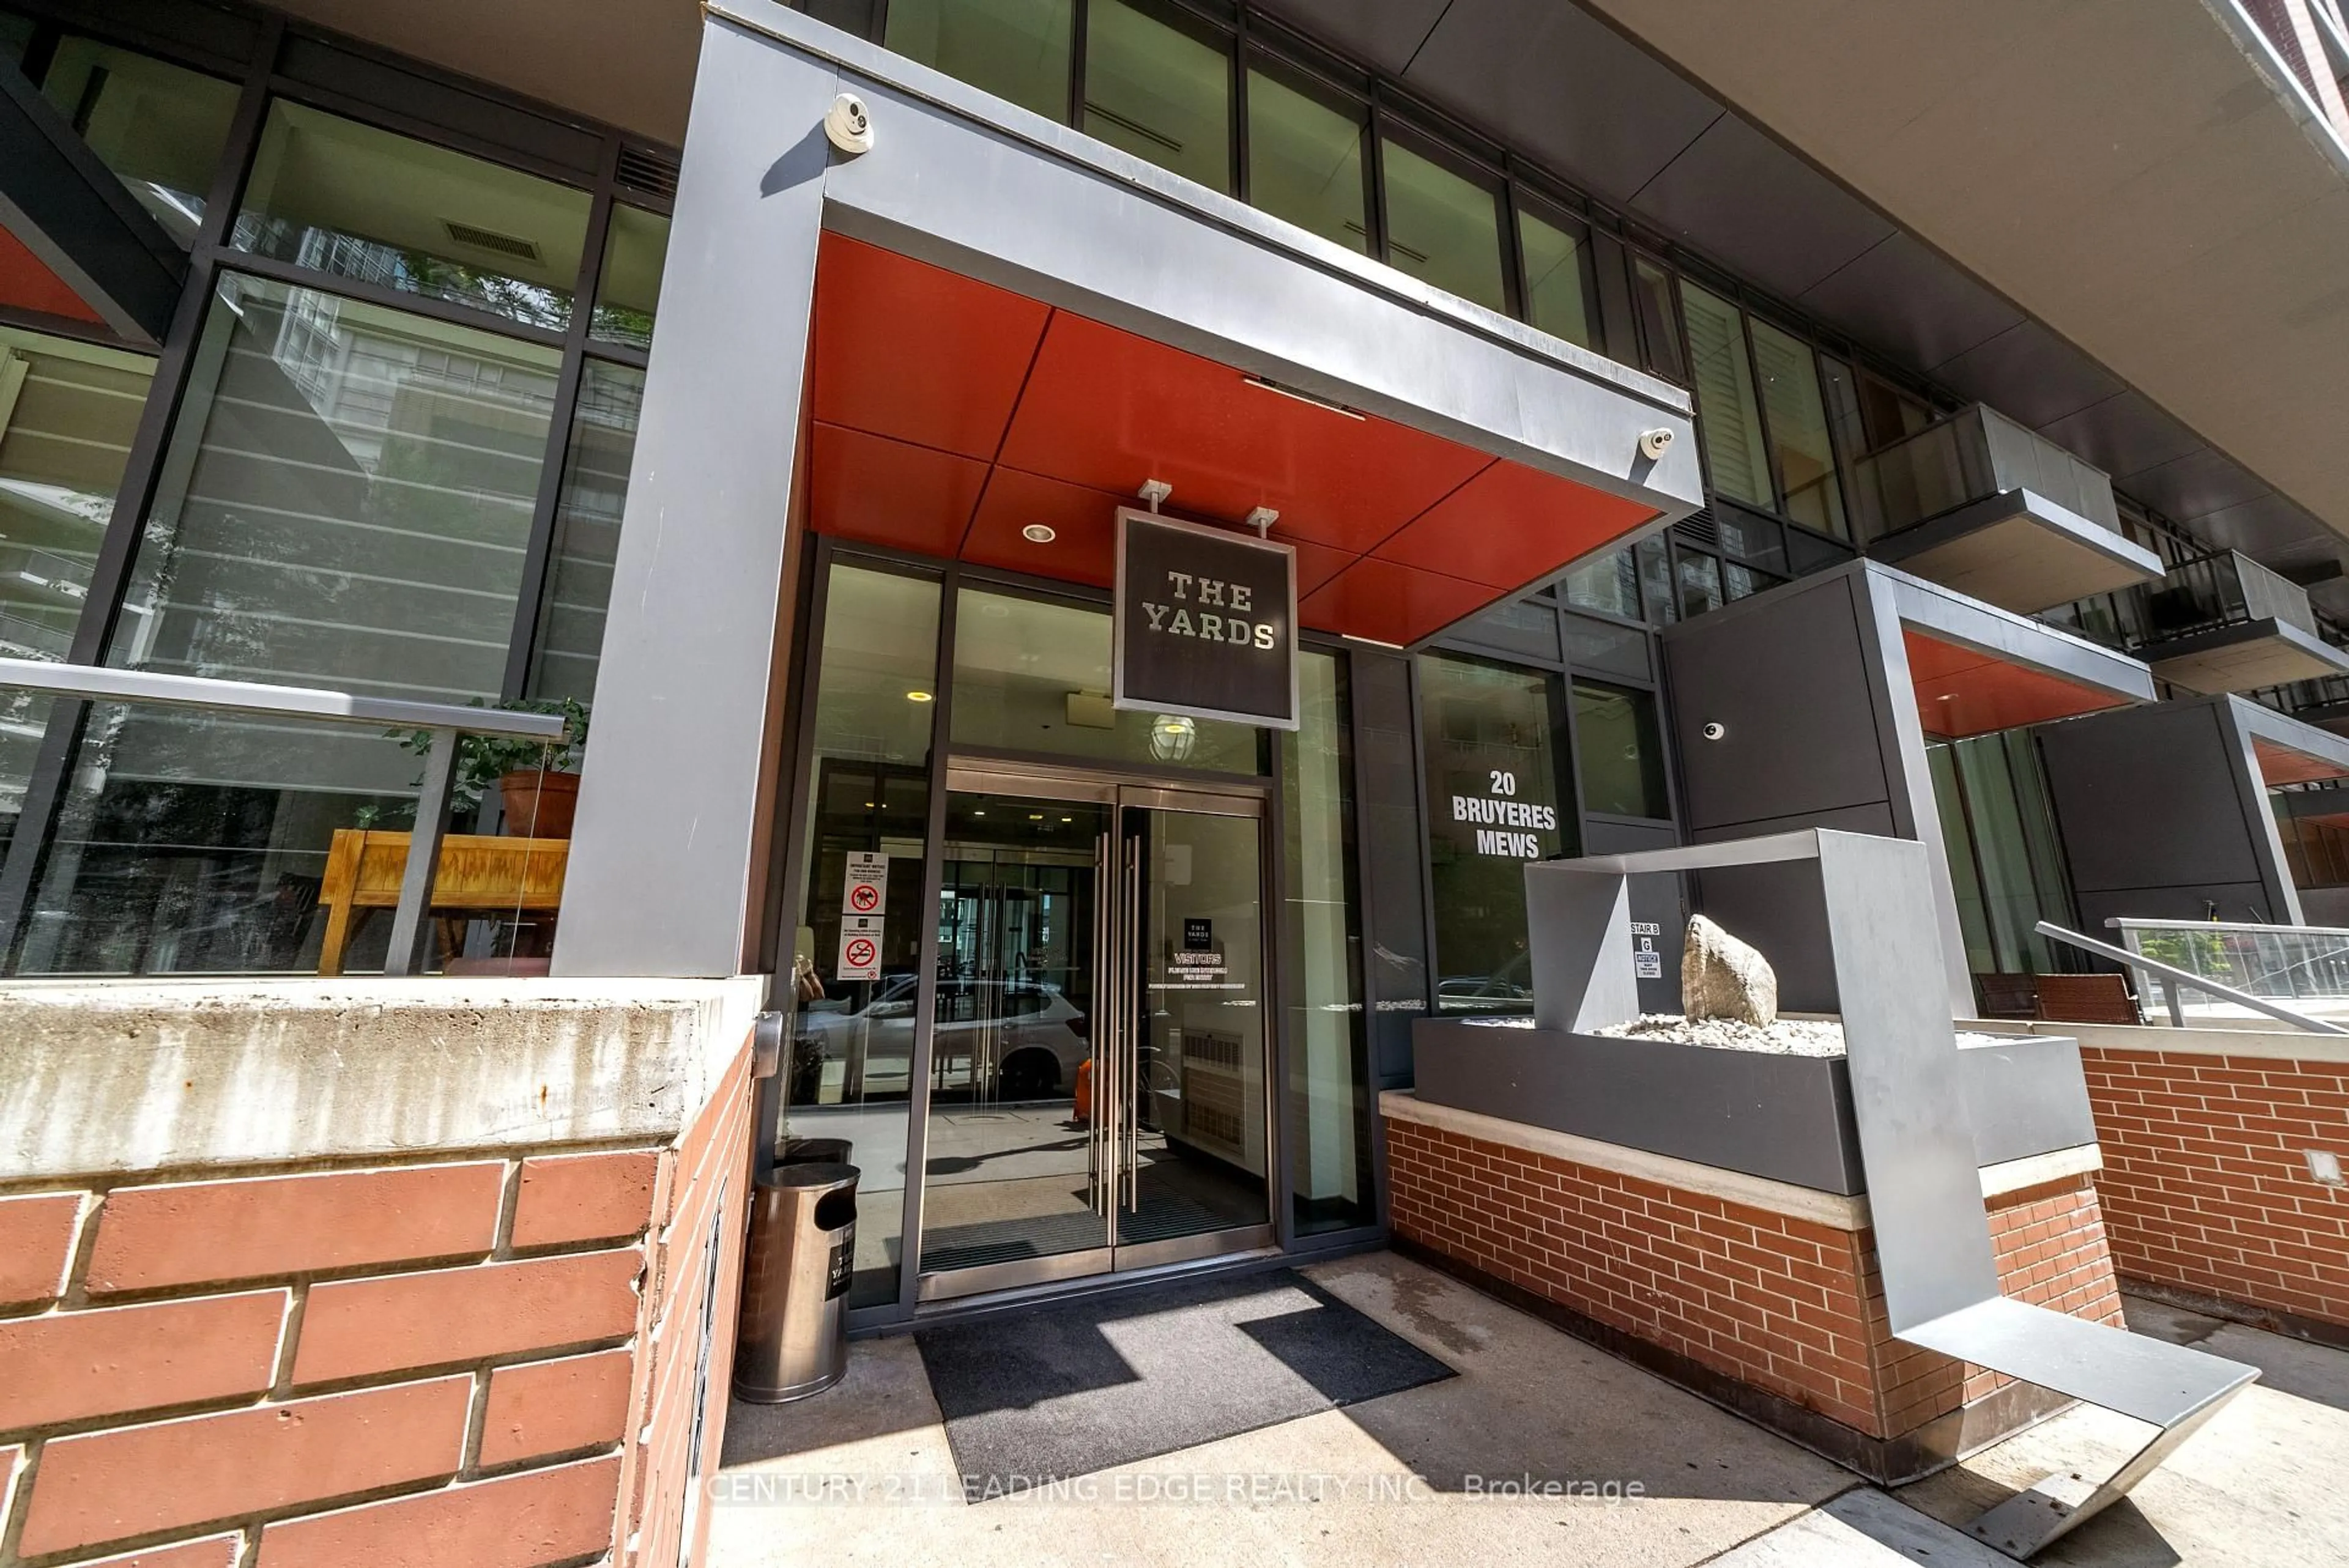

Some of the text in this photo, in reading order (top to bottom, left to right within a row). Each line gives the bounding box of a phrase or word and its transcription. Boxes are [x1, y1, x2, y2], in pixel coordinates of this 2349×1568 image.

[1168, 571, 1252, 611] THE
[1142, 602, 1275, 649] YARDS
[1490, 771, 1515, 796] 20
[1452, 796, 1556, 830] BRUYERES
[1476, 829, 1539, 858] MEWS
[1631, 923, 1658, 934] STAIR B
[1174, 953, 1222, 964] VISITORS
[1643, 941, 1650, 950] G
